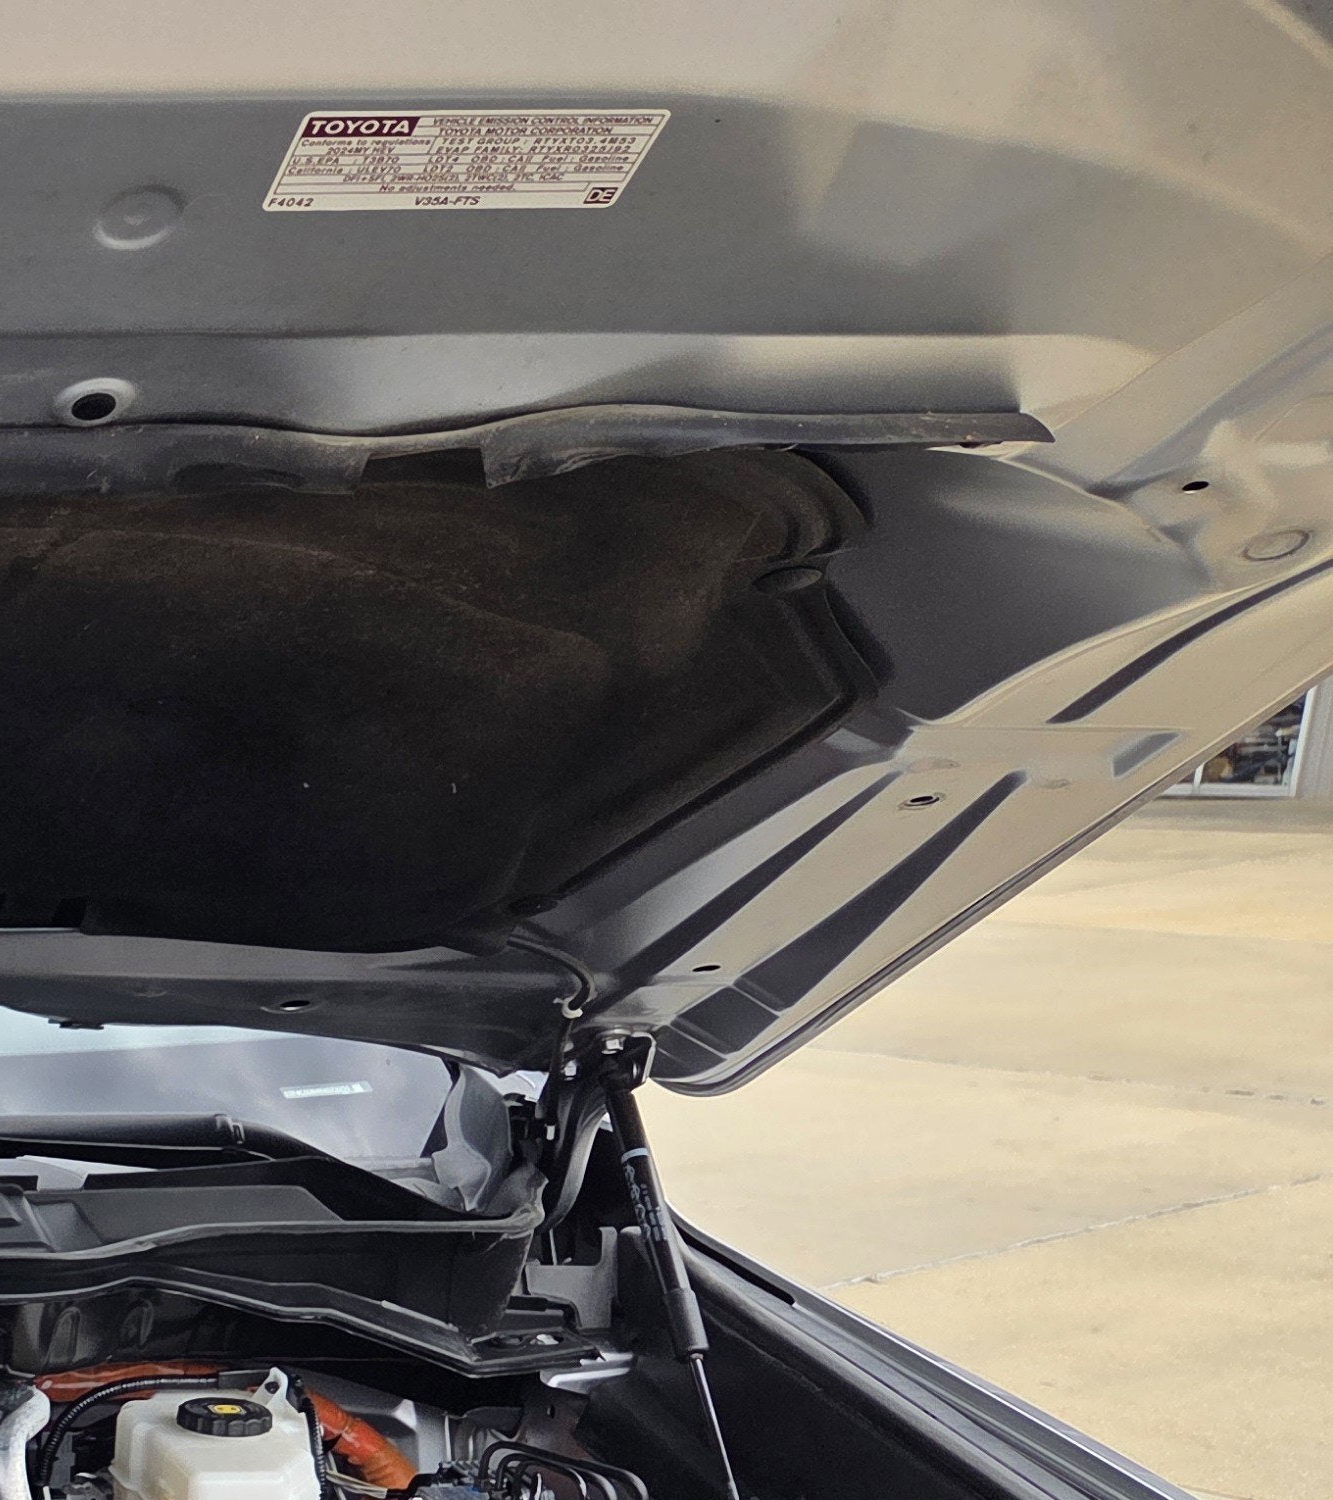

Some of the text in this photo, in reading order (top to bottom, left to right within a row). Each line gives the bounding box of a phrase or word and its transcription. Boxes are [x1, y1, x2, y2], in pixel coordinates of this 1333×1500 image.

[531, 117, 579, 125] CONTROL
[582, 116, 654, 124] INFORMATION
[310, 119, 410, 135] TOYOTA
[439, 127, 613, 135] TOYOTA MOTOR CORPORATION
[300, 138, 431, 148] Conforms to regulations
[441, 137, 475, 145] TEST
[477, 137, 520, 145] GROUP
[541, 154, 568, 162] Fuel
[579, 154, 630, 162] Gasoline
[287, 167, 344, 175] California
[536, 163, 563, 171] Fuel
[574, 163, 624, 171] Gasoline
[379, 184, 396, 192] No
[399, 183, 467, 192] adjustments
[586, 189, 616, 203] DE
[268, 197, 315, 208] F4042
